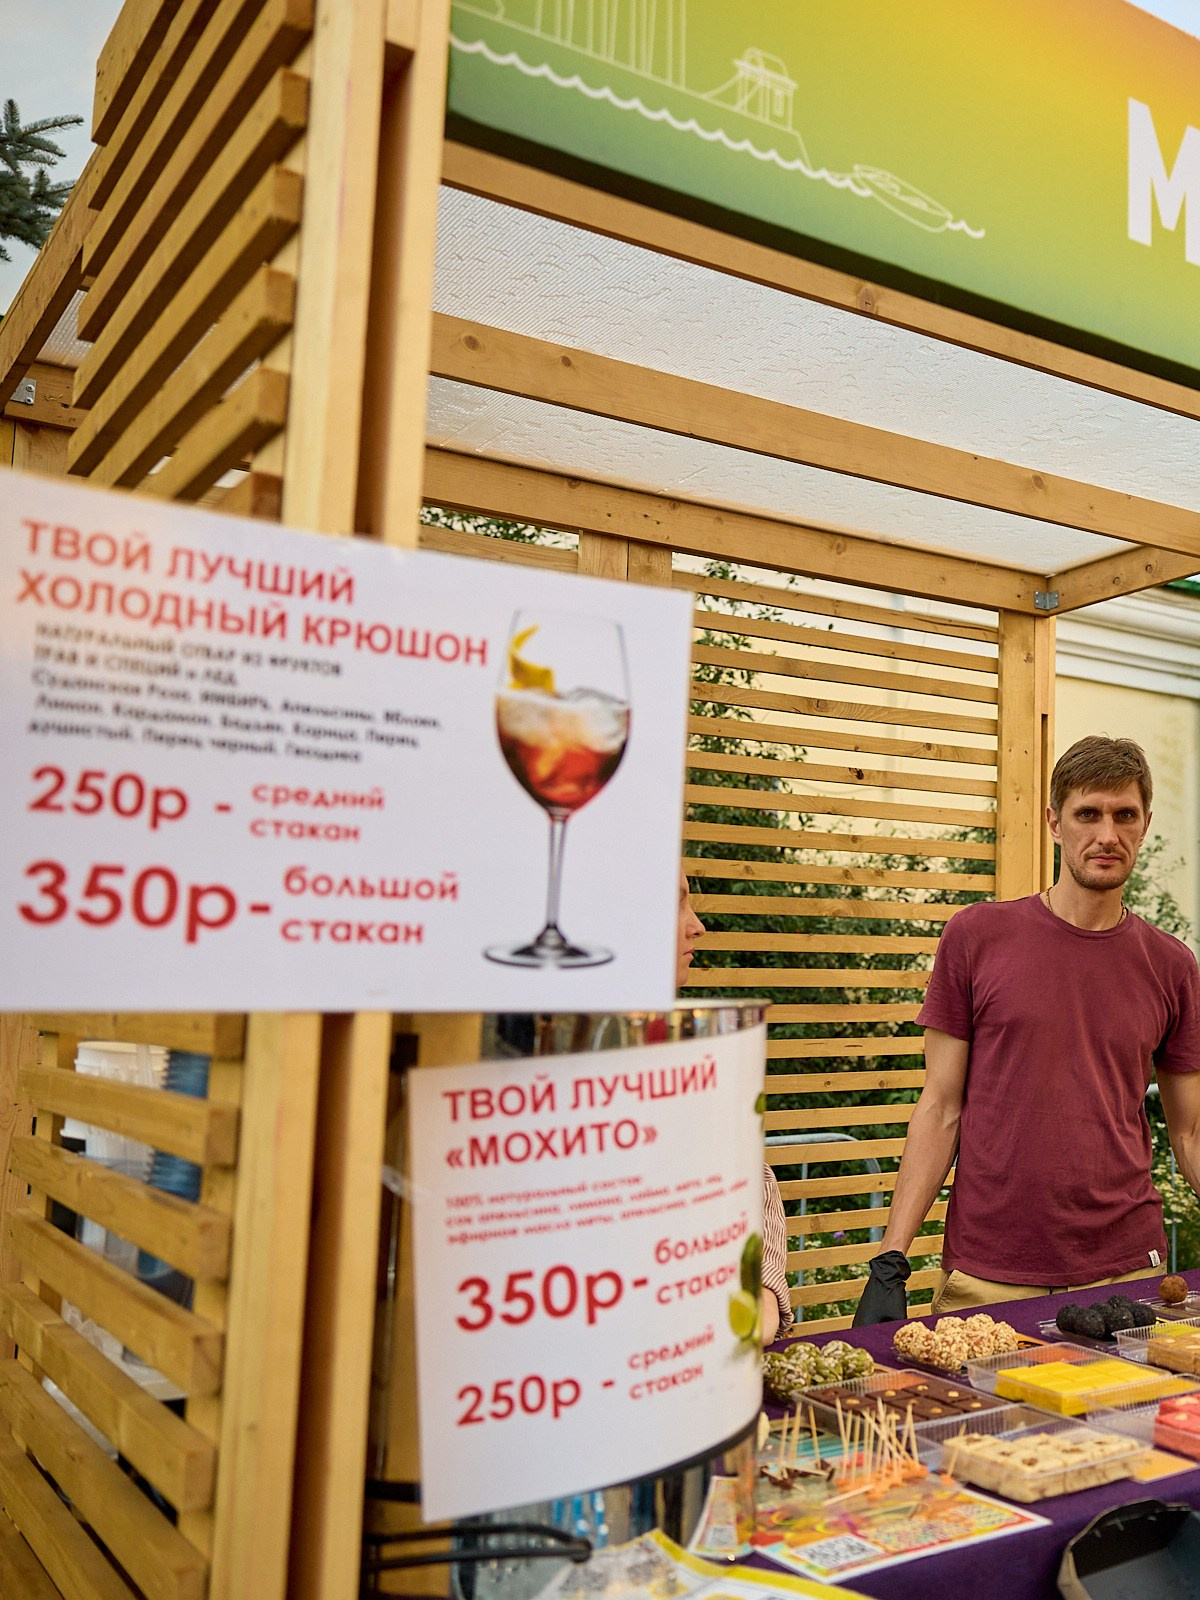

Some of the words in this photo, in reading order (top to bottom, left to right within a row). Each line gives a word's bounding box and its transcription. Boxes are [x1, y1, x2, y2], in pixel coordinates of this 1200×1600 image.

[21, 517, 151, 574] ТВОЙ
[168, 545, 355, 606] ЛУЧШИЙ
[17, 568, 288, 641] ХОЛОДНЫЙ
[302, 613, 489, 667] КРЮШОН
[28, 765, 188, 831] 250р
[251, 782, 385, 811] средний
[249, 817, 360, 842] стакан
[283, 864, 460, 902] большой
[280, 918, 424, 945] стакан
[443, 1074, 556, 1122] ТВОЙ
[571, 1054, 717, 1110] ЛУЧШИЙ
[446, 1119, 659, 1169] «МОХИТО»
[654, 1211, 749, 1265] большой
[628, 1324, 716, 1370] средний
[456, 1373, 582, 1427] 250р
[629, 1364, 704, 1401] стакан
